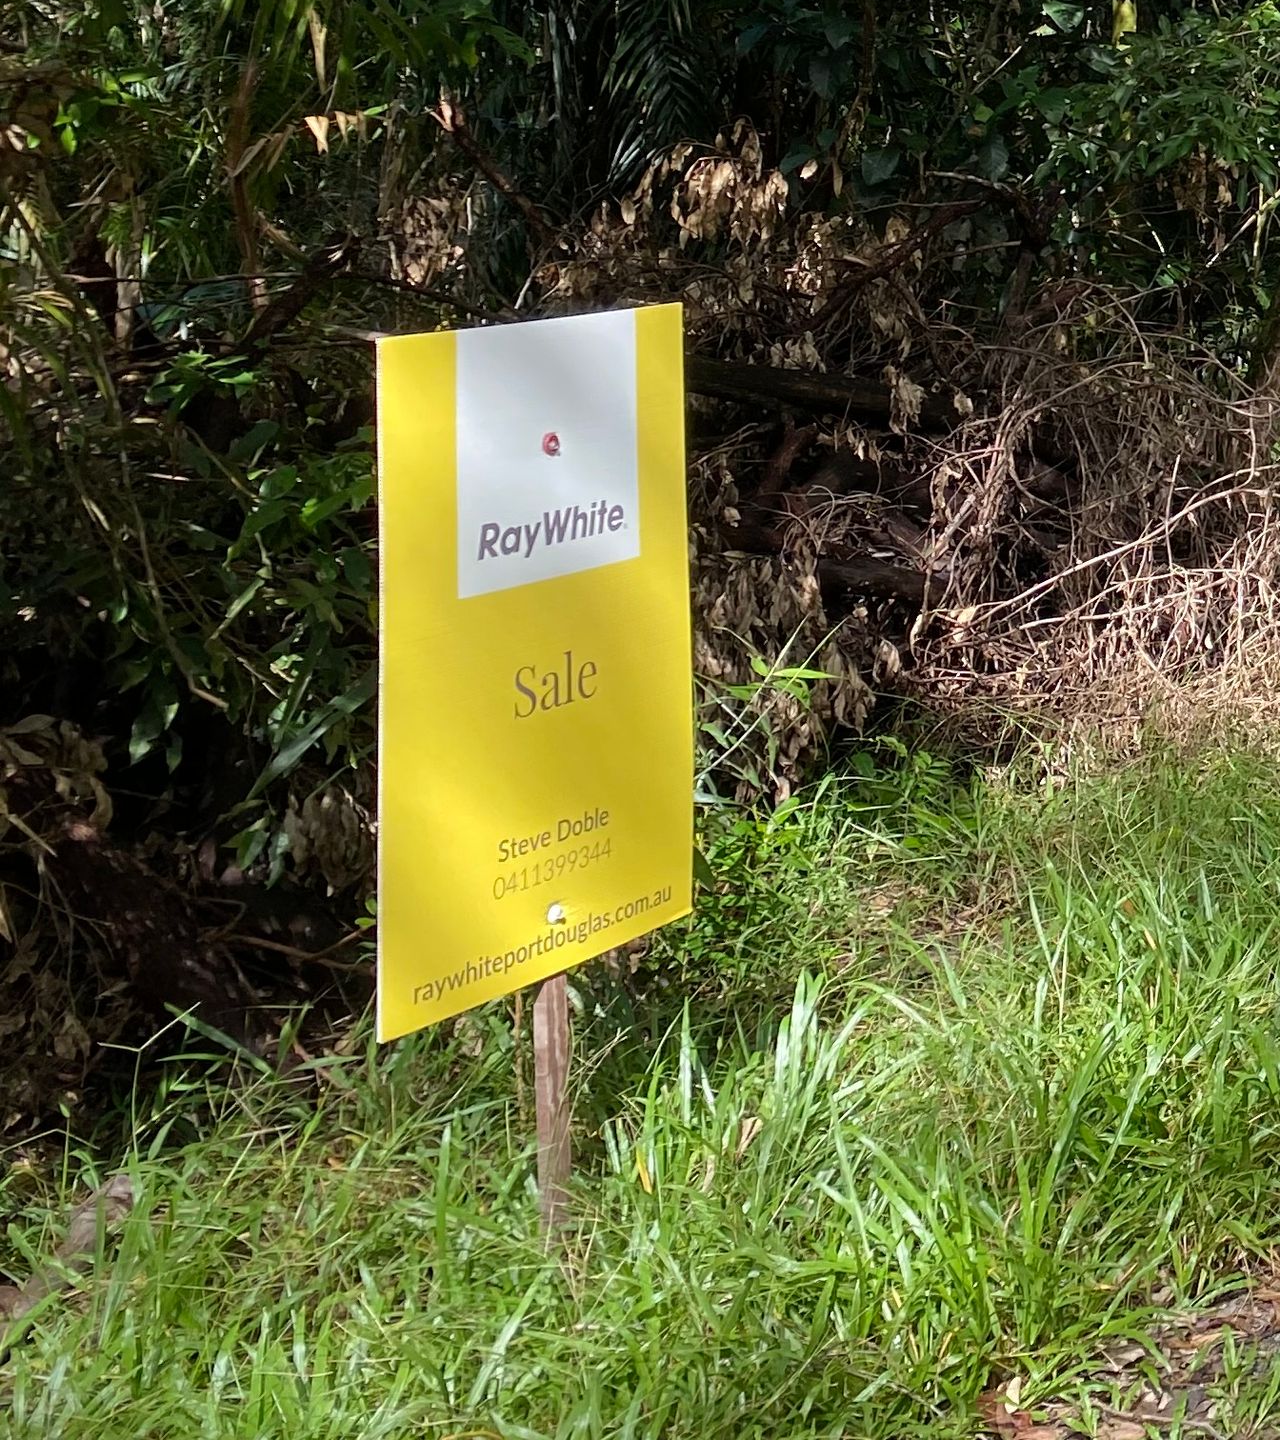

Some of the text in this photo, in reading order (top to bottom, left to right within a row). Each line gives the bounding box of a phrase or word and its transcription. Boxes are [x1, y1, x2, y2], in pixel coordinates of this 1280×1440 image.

[513, 650, 598, 720] Sale
[498, 807, 609, 863] Steve Doble
[492, 837, 613, 901] 0411399344
[412, 885, 672, 1005] raywhiteportdouglas.com.au
